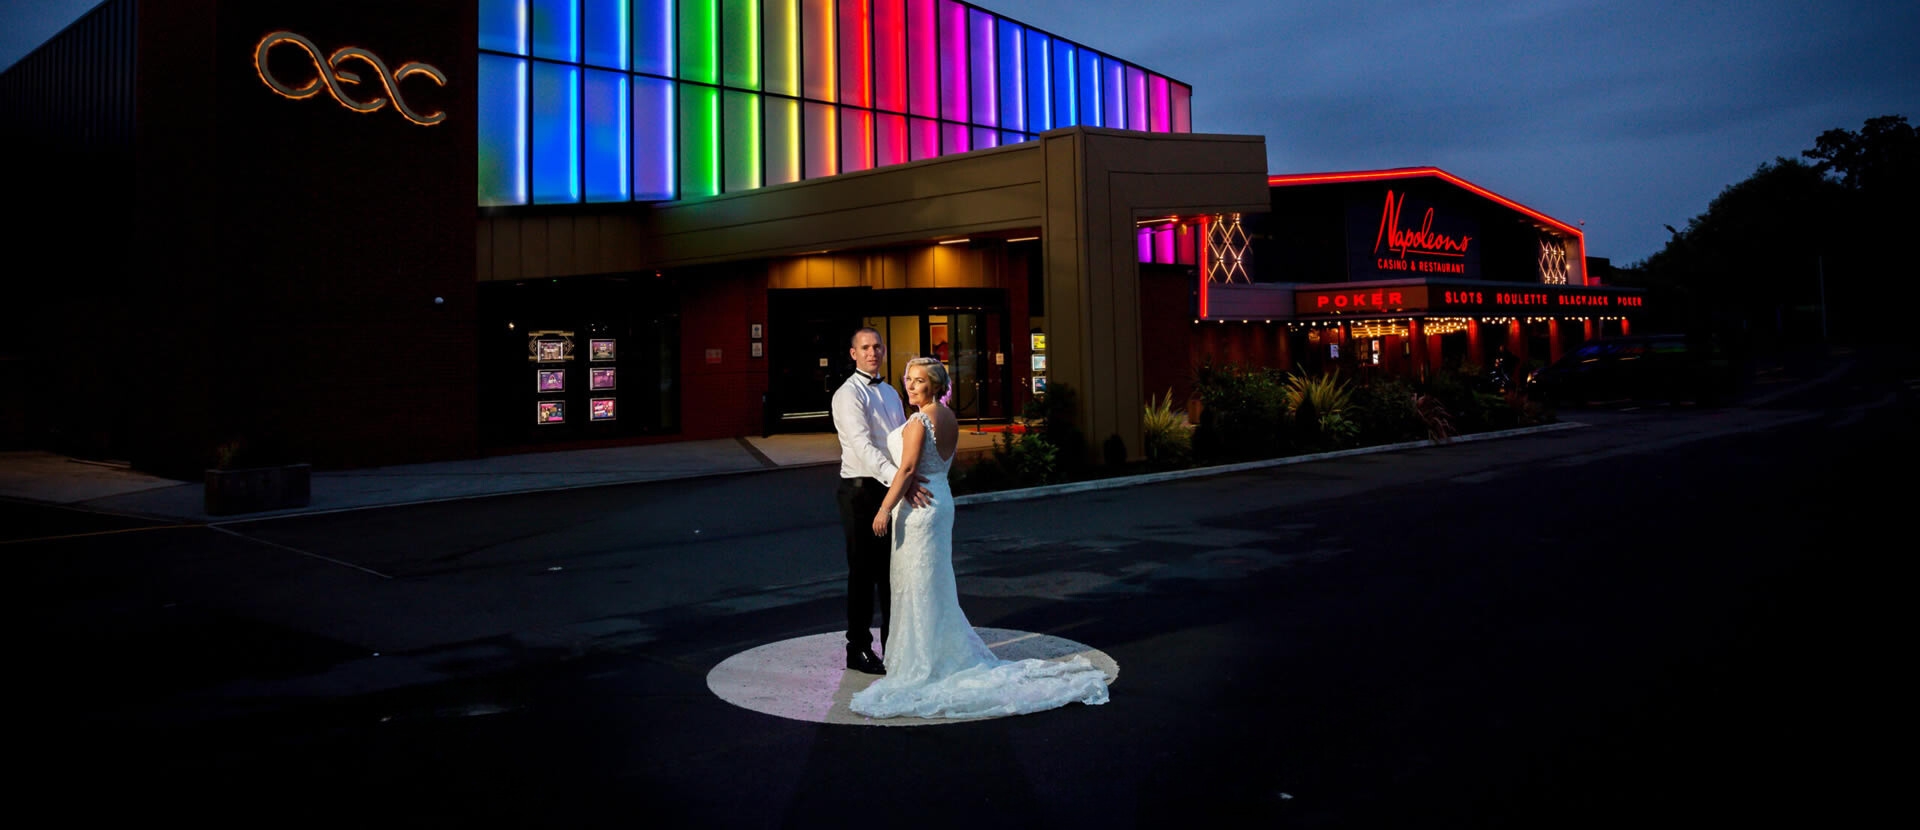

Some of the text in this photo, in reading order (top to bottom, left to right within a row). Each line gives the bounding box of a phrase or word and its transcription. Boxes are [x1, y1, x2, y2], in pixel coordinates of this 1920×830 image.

[1374, 189, 1472, 259] Napoleons
[1377, 257, 1465, 274] CASINO & RESTAURANT
[1317, 292, 1403, 308] POKER
[1444, 290, 1642, 307] SLOTS ROULETTE BLACKJACK POKER
